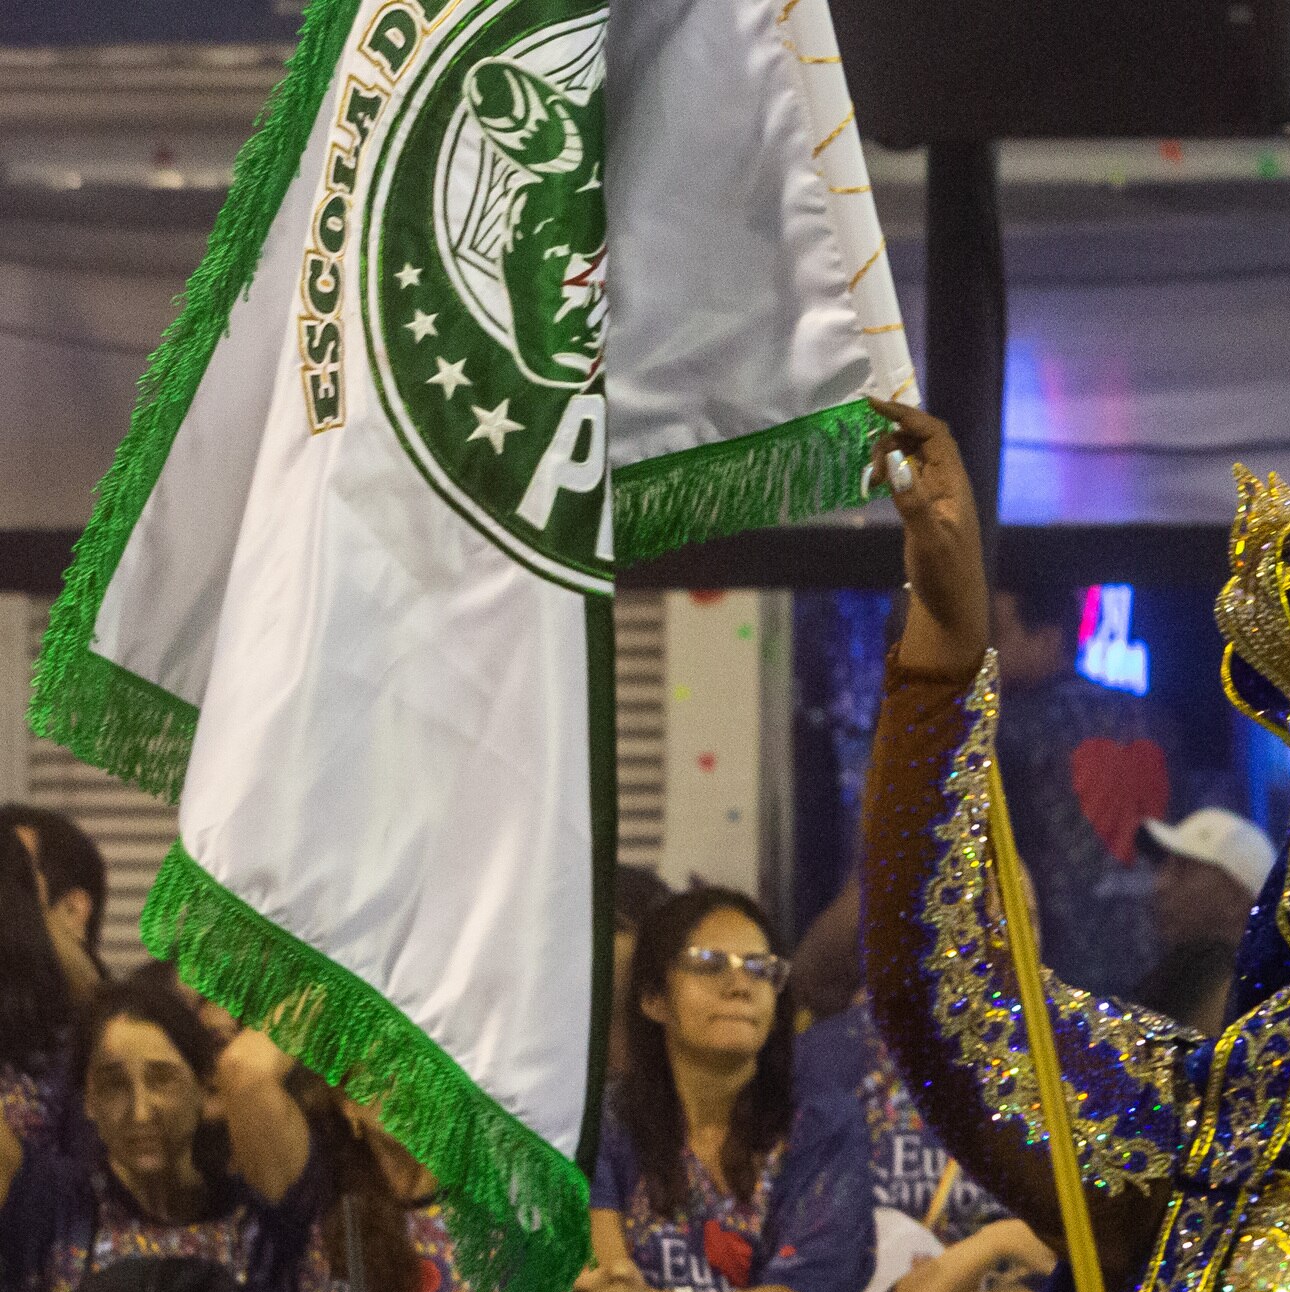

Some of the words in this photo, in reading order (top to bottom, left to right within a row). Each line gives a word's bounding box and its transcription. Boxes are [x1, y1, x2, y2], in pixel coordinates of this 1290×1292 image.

[297, 74, 392, 435] ESCOLA
[892, 1134, 949, 1178] Eu
[662, 1238, 714, 1285] Eu
